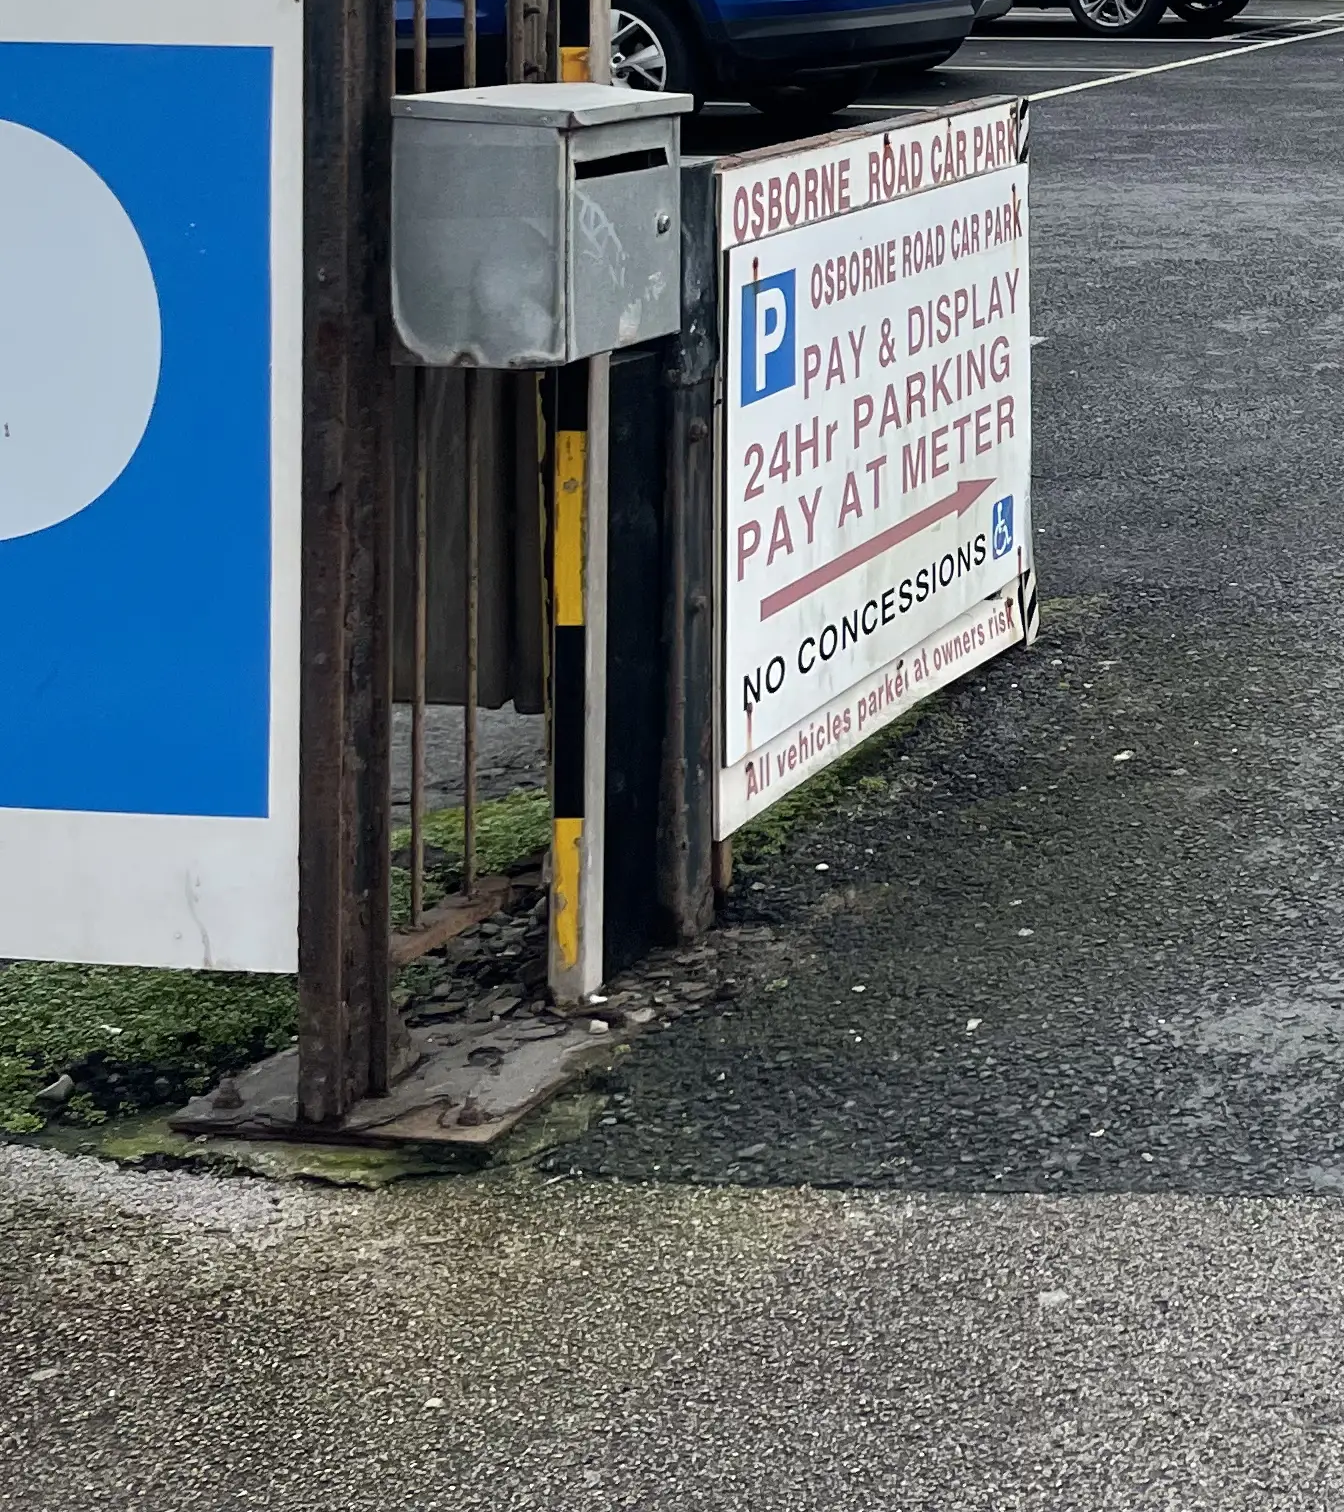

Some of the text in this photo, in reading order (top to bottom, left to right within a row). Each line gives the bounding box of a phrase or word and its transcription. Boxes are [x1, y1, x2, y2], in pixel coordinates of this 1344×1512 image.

[733, 118, 1017, 242] OSBORNE ROAD CAR PARK
[811, 198, 1022, 310] OSBORNE ROAD CAR PARK
[755, 287, 786, 393] P
[803, 268, 1020, 400] PAY & DISPLAY
[737, 394, 1015, 582] PAY AT METER
[744, 335, 1011, 502] 24Hr PARKING
[743, 533, 986, 711] NO CONCESSIONS
[744, 752, 771, 801] All
[776, 707, 851, 777] vehicles
[913, 647, 931, 682] at
[933, 623, 986, 671] owners
[988, 600, 1016, 640] risk
